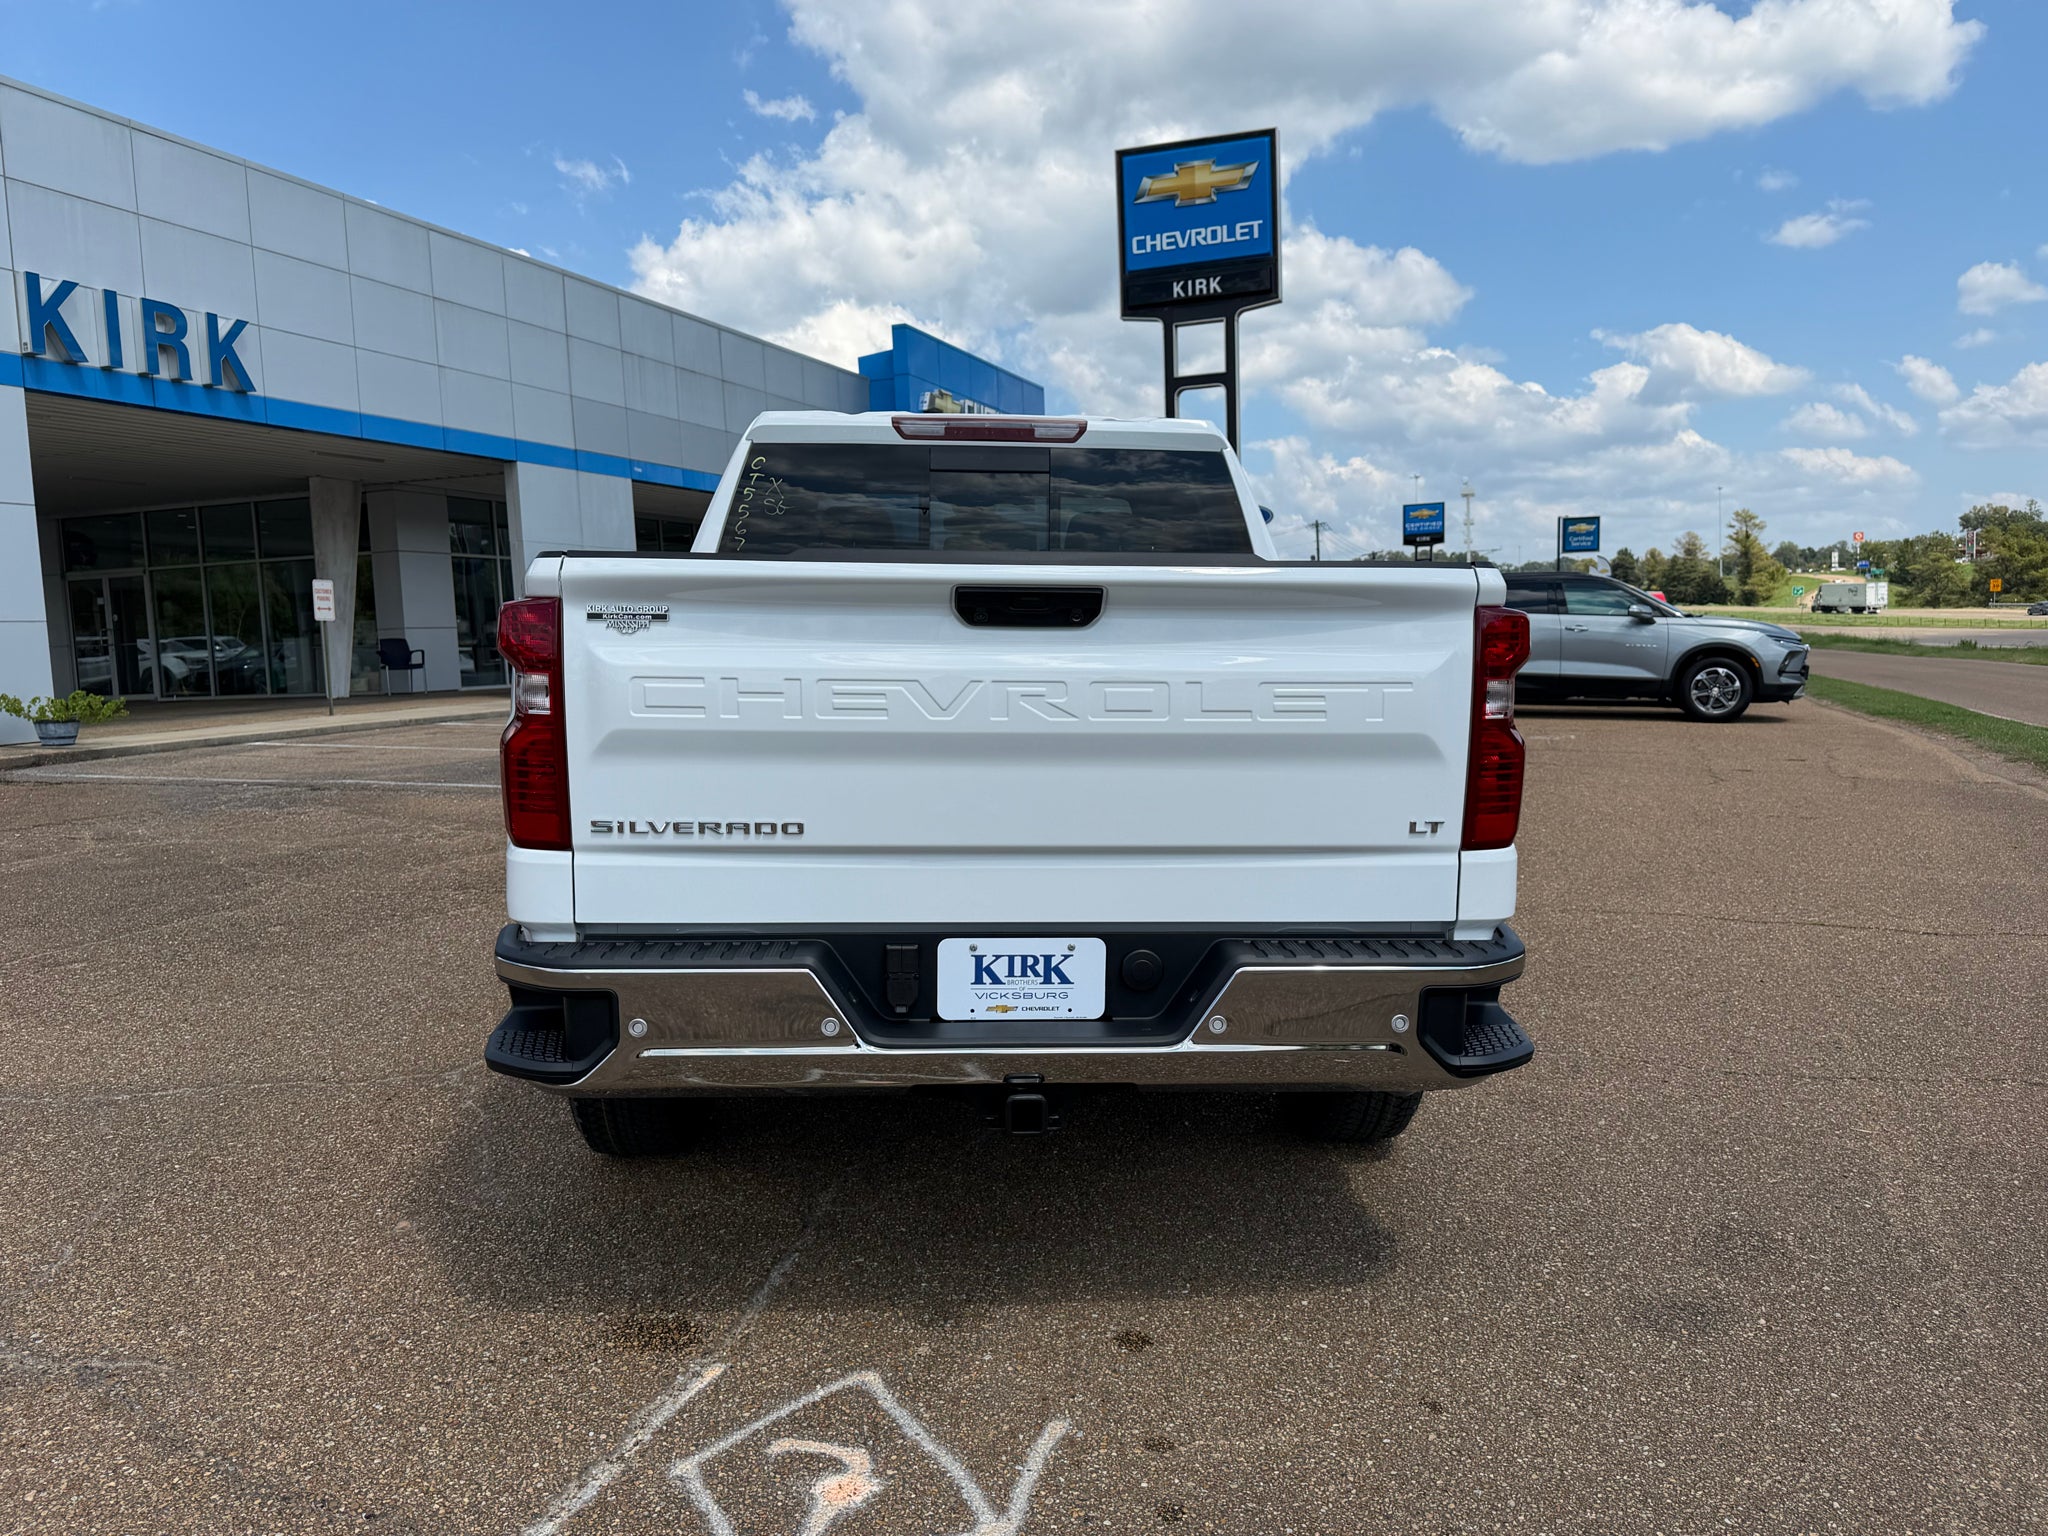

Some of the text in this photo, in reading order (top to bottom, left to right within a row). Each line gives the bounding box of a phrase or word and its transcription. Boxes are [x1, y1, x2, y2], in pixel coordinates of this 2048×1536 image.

[1132, 220, 1263, 254] CHEVROLET
[1173, 276, 1222, 298] KIRK
[24, 271, 257, 393] KIRK
[586, 604, 669, 613] KIRK AUTO GROUP
[629, 676, 1414, 722] CHEVROLET
[590, 820, 805, 835] SILVERADO
[1409, 821, 1445, 834] LT
[970, 954, 1075, 985] KIRK
[974, 991, 1069, 1000] VICKSBURG
